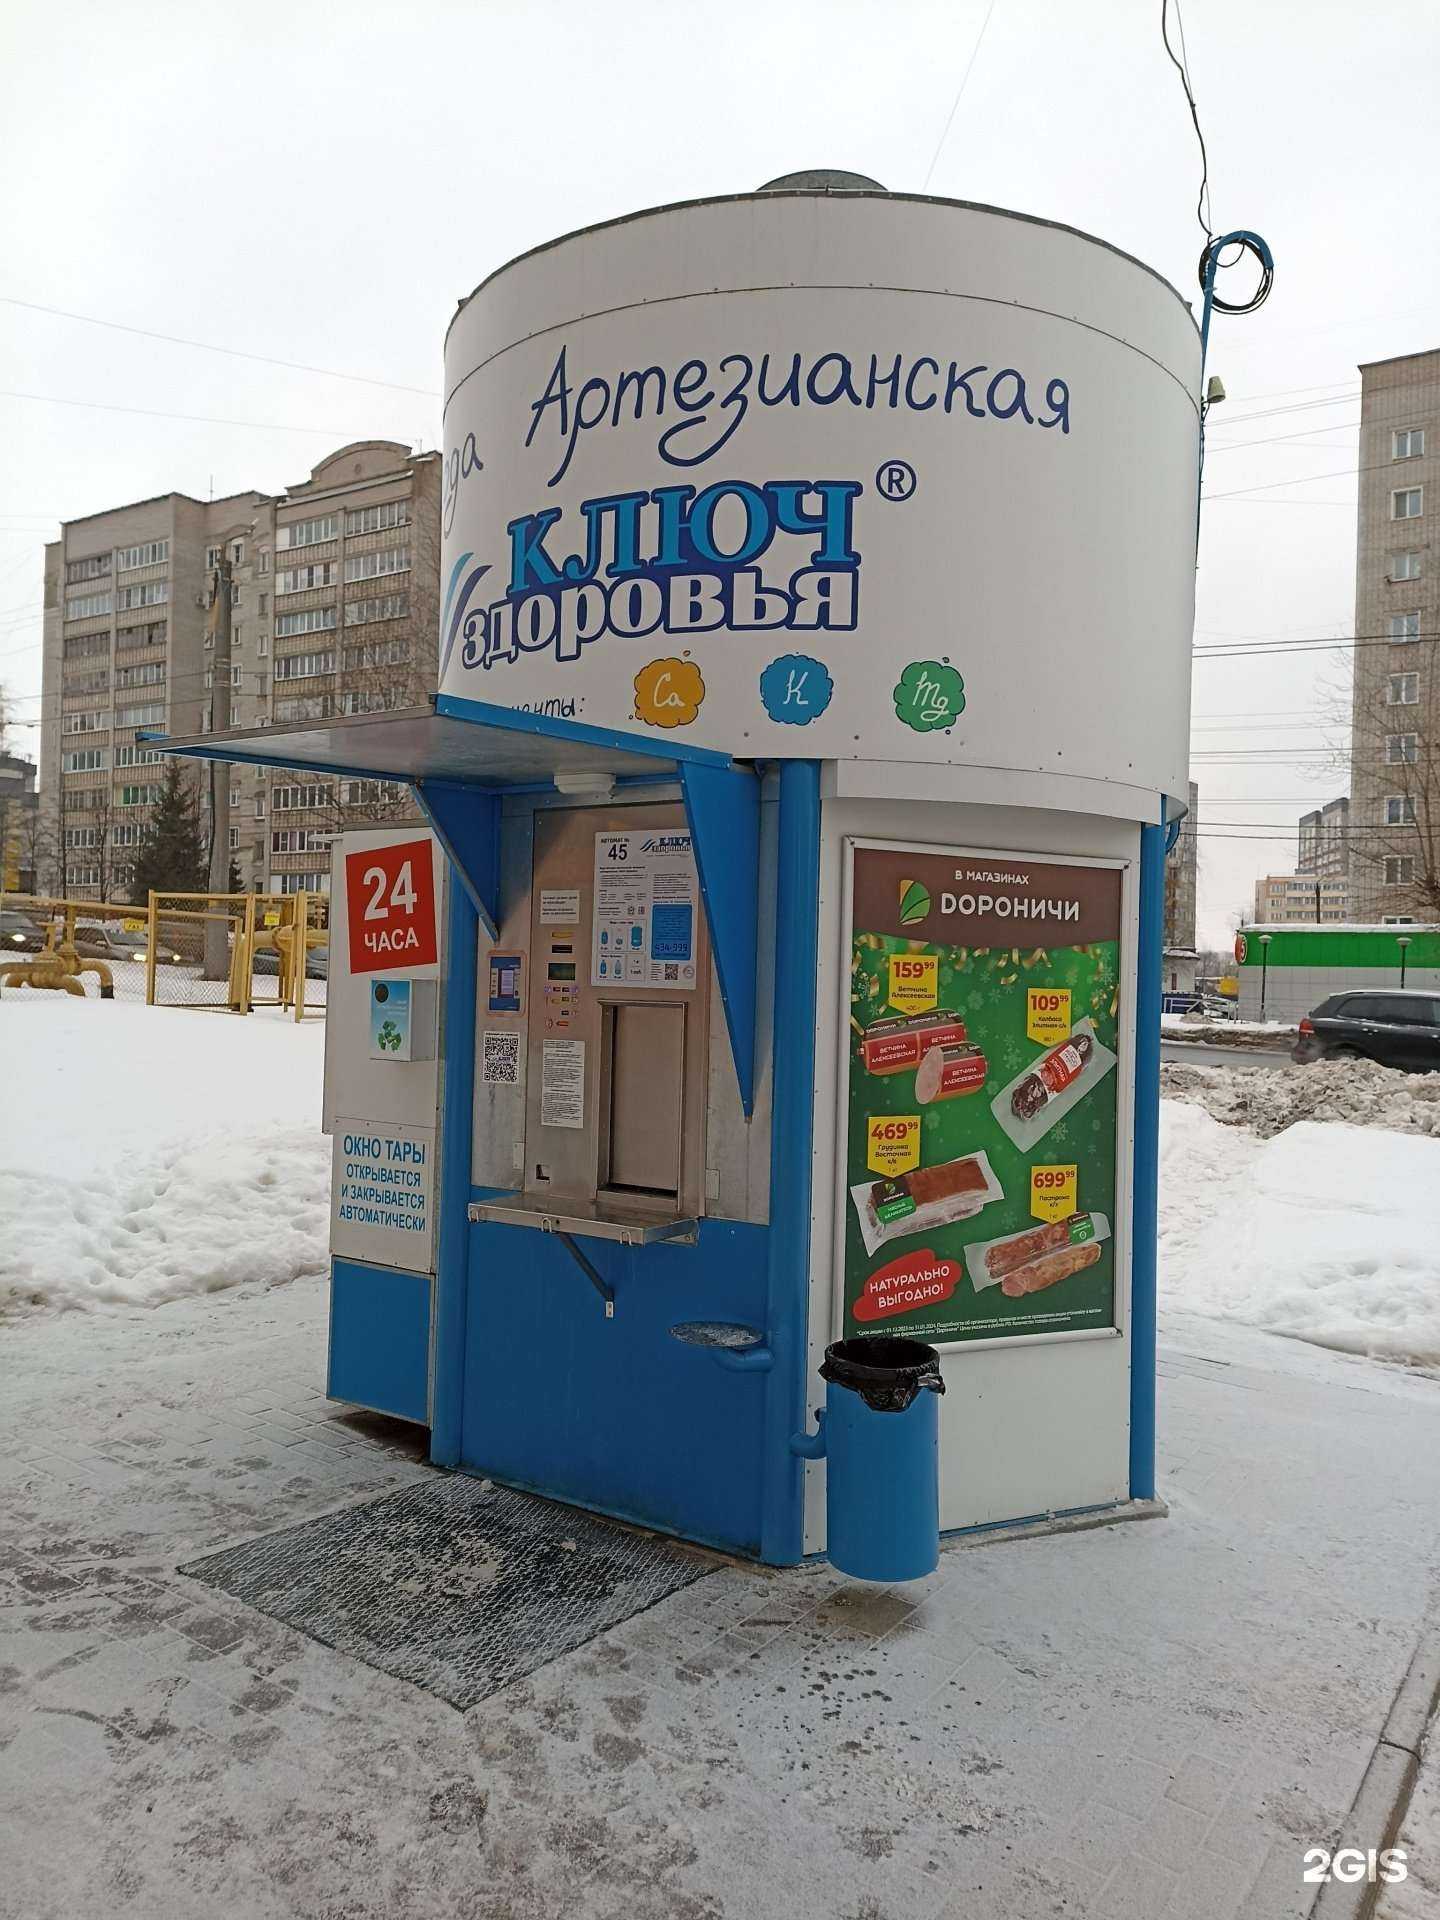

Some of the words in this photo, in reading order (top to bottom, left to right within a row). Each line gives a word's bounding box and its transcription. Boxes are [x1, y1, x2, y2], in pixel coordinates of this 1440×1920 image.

[443, 431, 484, 540] да
[525, 344, 1071, 487] Артезианская
[607, 843, 628, 860] 45
[362, 860, 418, 921] 24
[954, 869, 963, 880] В
[966, 871, 1030, 885] МАГАЗИНАХ
[363, 927, 420, 953] ЧАСА
[343, 1134, 381, 1159] ОКНО
[384, 1140, 426, 1165] ТАРЫ
[346, 1163, 421, 1188] ОТКРЫВАЕТСЯ
[341, 1184, 348, 1198] И
[350, 1184, 425, 1210] ЗАКРЫВАЕТСЯ
[338, 1204, 426, 1232] АВТОМАТИЧЕСКИ
[869, 1265, 950, 1294] НАТУРАЛЬНО
[877, 1282, 944, 1309] ВЫГОДНО!
